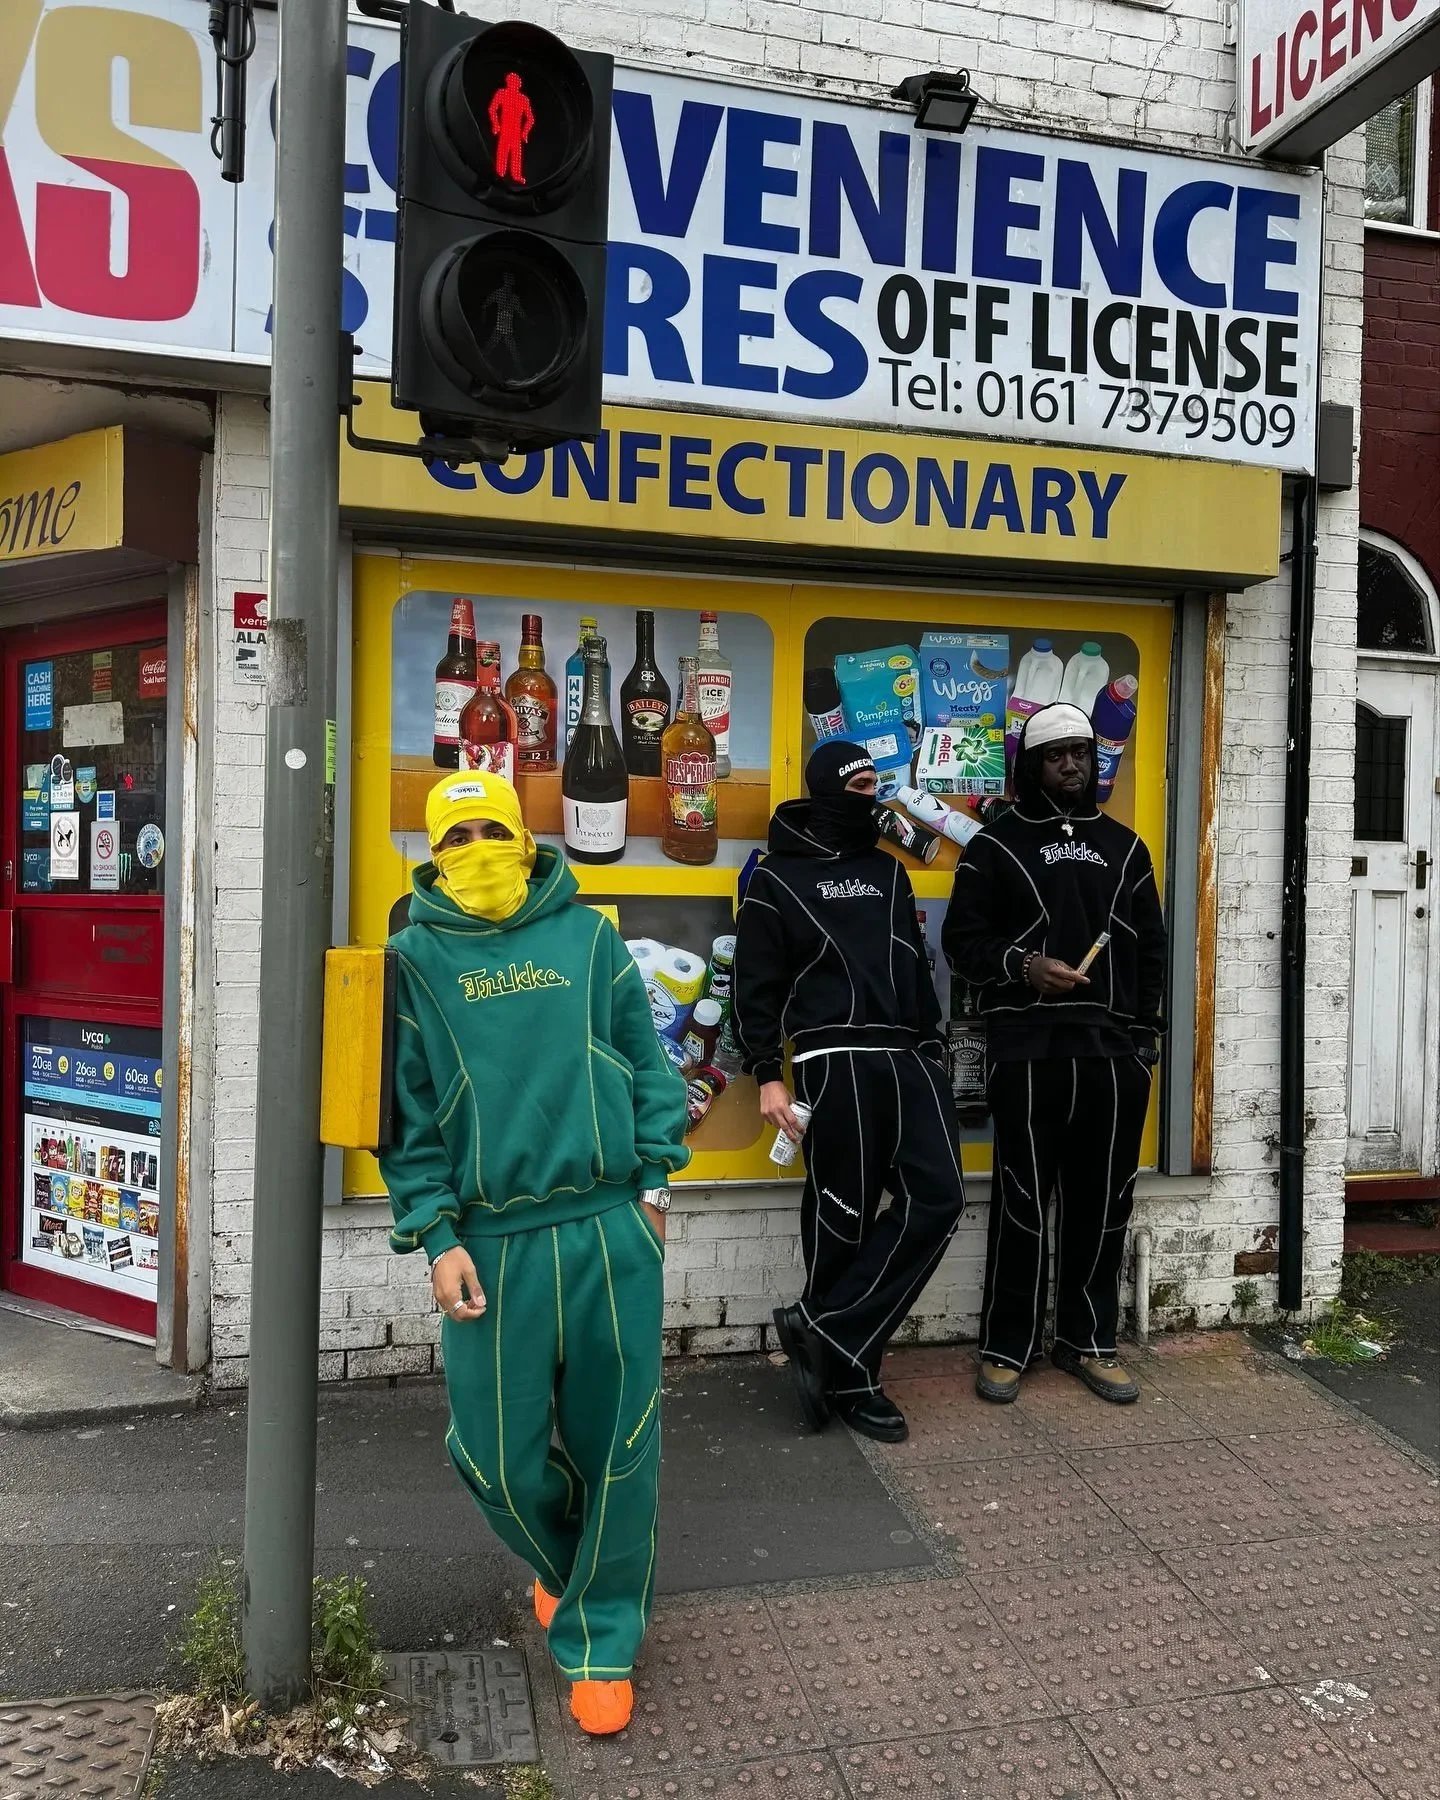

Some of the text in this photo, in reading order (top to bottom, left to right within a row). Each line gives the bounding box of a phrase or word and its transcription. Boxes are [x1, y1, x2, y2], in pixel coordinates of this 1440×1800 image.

[0, 6, 202, 322] S
[270, 46, 1299, 317] VENIENCE
[265, 207, 869, 400] RES
[877, 273, 1299, 398] OFF LICENSE
[878, 356, 1296, 448] Tel: 0161 7379509
[929, 635, 963, 645] Wagg
[28, 671, 51, 686] CASH
[143, 675, 166, 685] Sold here
[28, 684, 51, 694] MACHINE
[589, 673, 600, 701] heart
[706, 688, 723, 697] ICE
[932, 677, 998, 704] Wagg
[28, 693, 51, 708] HERE
[569, 679, 580, 722] WKD
[629, 700, 667, 713] BAILEYS
[949, 704, 981, 712] Meaty
[856, 708, 899, 723] Pampers
[531, 752, 541, 760] 12
[937, 733, 952, 767] ARIEL
[24, 853, 38, 862] Lyca
[82, 1028, 104, 1045] Lyca
[949, 1041, 964, 1052] JACK
[32, 1055, 52, 1071] 20GB
[75, 1061, 97, 1077] 26GB
[125, 1068, 149, 1085] 60GB
